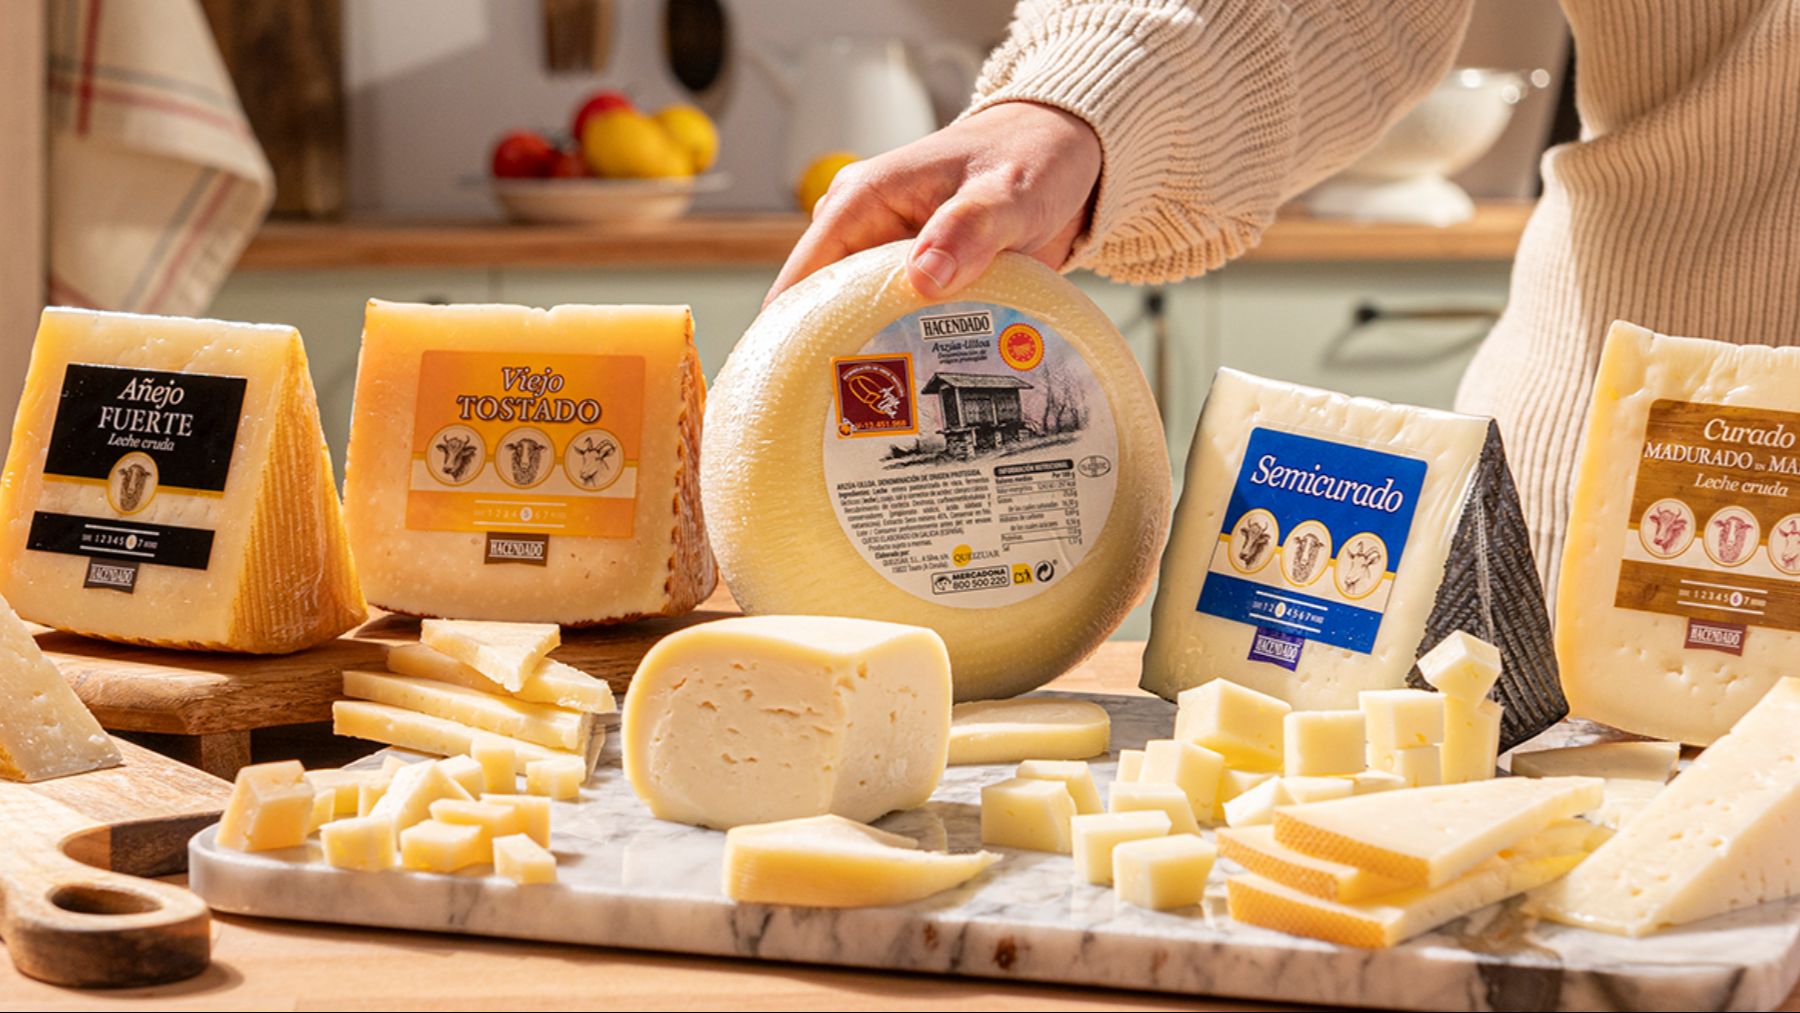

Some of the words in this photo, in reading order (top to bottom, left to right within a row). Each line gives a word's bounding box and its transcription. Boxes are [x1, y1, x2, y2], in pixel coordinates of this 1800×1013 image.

[923, 315, 990, 337] HACENDADO
[117, 377, 186, 410] Añejo
[501, 366, 564, 398] Viejo
[97, 406, 194, 437] FUERTE
[456, 395, 602, 424] TOSTADO
[107, 433, 141, 448] Leche
[141, 437, 176, 452] cruda
[1703, 418, 1797, 450] Curado
[1643, 441, 1753, 470] MADURADO
[1768, 455, 1800, 476] MA
[1251, 454, 1404, 513] Semicurado
[1694, 473, 1740, 492] Leche
[1741, 481, 1790, 498] cruda
[491, 542, 544, 557] HACENDADO
[953, 550, 1001, 563] QUEIZUAR
[952, 568, 1006, 580] MERCADONA
[953, 580, 971, 590] 800
[972, 577, 990, 588] 500
[990, 575, 1006, 586] 220
